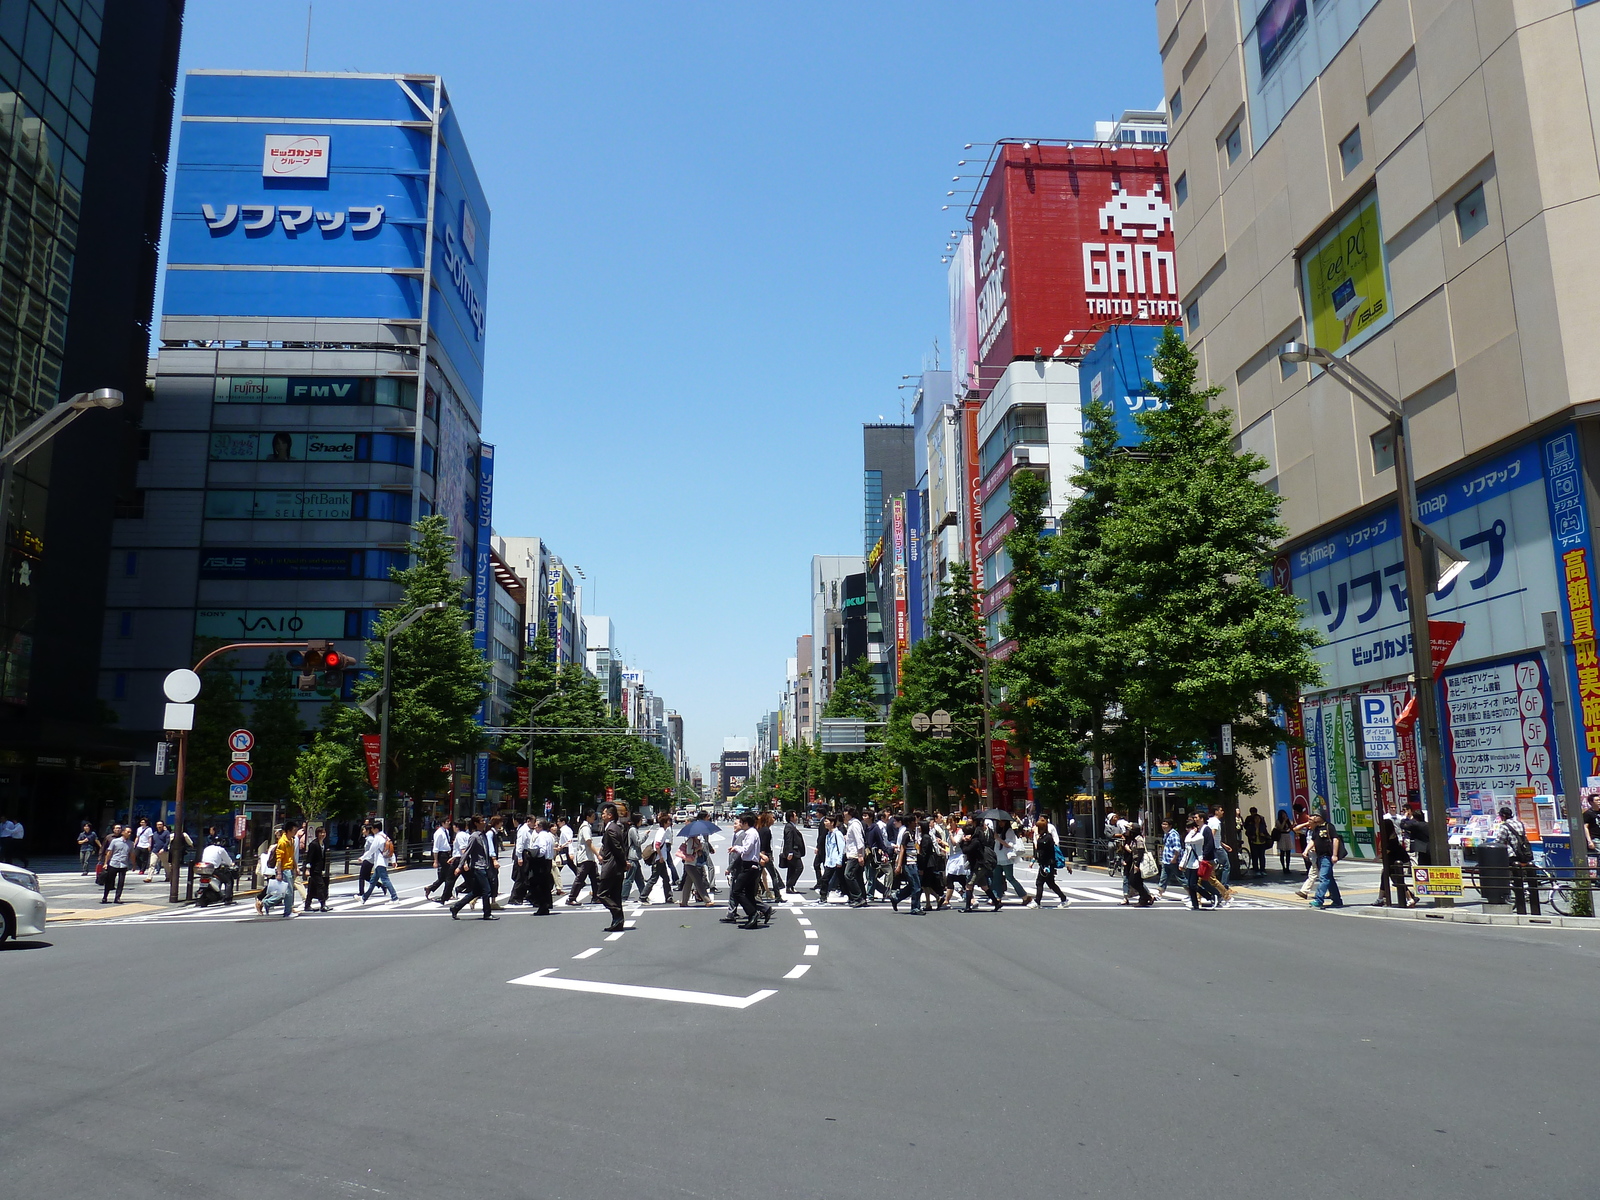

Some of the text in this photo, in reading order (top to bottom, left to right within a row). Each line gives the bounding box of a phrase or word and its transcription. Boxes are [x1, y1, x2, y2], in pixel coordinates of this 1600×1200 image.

[270, 149, 322, 158] ビックカメラ
[281, 158, 310, 166] グループ
[202, 204, 385, 232] ソフマップ
[1083, 243, 1177, 295] GAM
[444, 224, 485, 342] Sofmap
[1086, 299, 1132, 316] TAITO
[1358, 299, 1383, 327] ASUS
[234, 382, 269, 396] FUJITSU
[294, 384, 352, 398] FMV
[1124, 396, 1173, 411] ソフ
[309, 442, 354, 452] Shade
[1551, 461, 1574, 477] パソコン
[1417, 459, 1521, 518] fmap ソフマップ
[295, 493, 349, 505] SoftBank
[481, 471, 492, 527] ソフマップ
[1555, 497, 1579, 512] デジカメ
[275, 509, 349, 518] SELECTION
[911, 528, 920, 561] animate
[1300, 518, 1387, 568] Sofmap ソフマップ
[1562, 536, 1581, 547] ゲーム
[203, 557, 247, 567] ASUS
[1317, 519, 1506, 633] ソフマプ
[475, 552, 488, 632] パソコン総合館
[238, 616, 303, 631] VAIO
[1521, 666, 1535, 684] 7F
[1364, 699, 1385, 724] P
[1451, 695, 1539, 713] デジタルオーディオ iPod 6F
[1480, 726, 1502, 736] サプライ
[1528, 723, 1541, 740] 5F
[1455, 738, 1492, 749] 組立PCパーツ
[1297, 748, 1307, 788] FREE
[1457, 752, 1489, 763] パソコン本体
[1531, 752, 1545, 768] 4F
[1458, 763, 1521, 774] パソコンソフト プリンタ
[1492, 780, 1522, 789] レコーダー
[1534, 780, 1548, 795] 3F
[1332, 808, 1347, 825] 100
